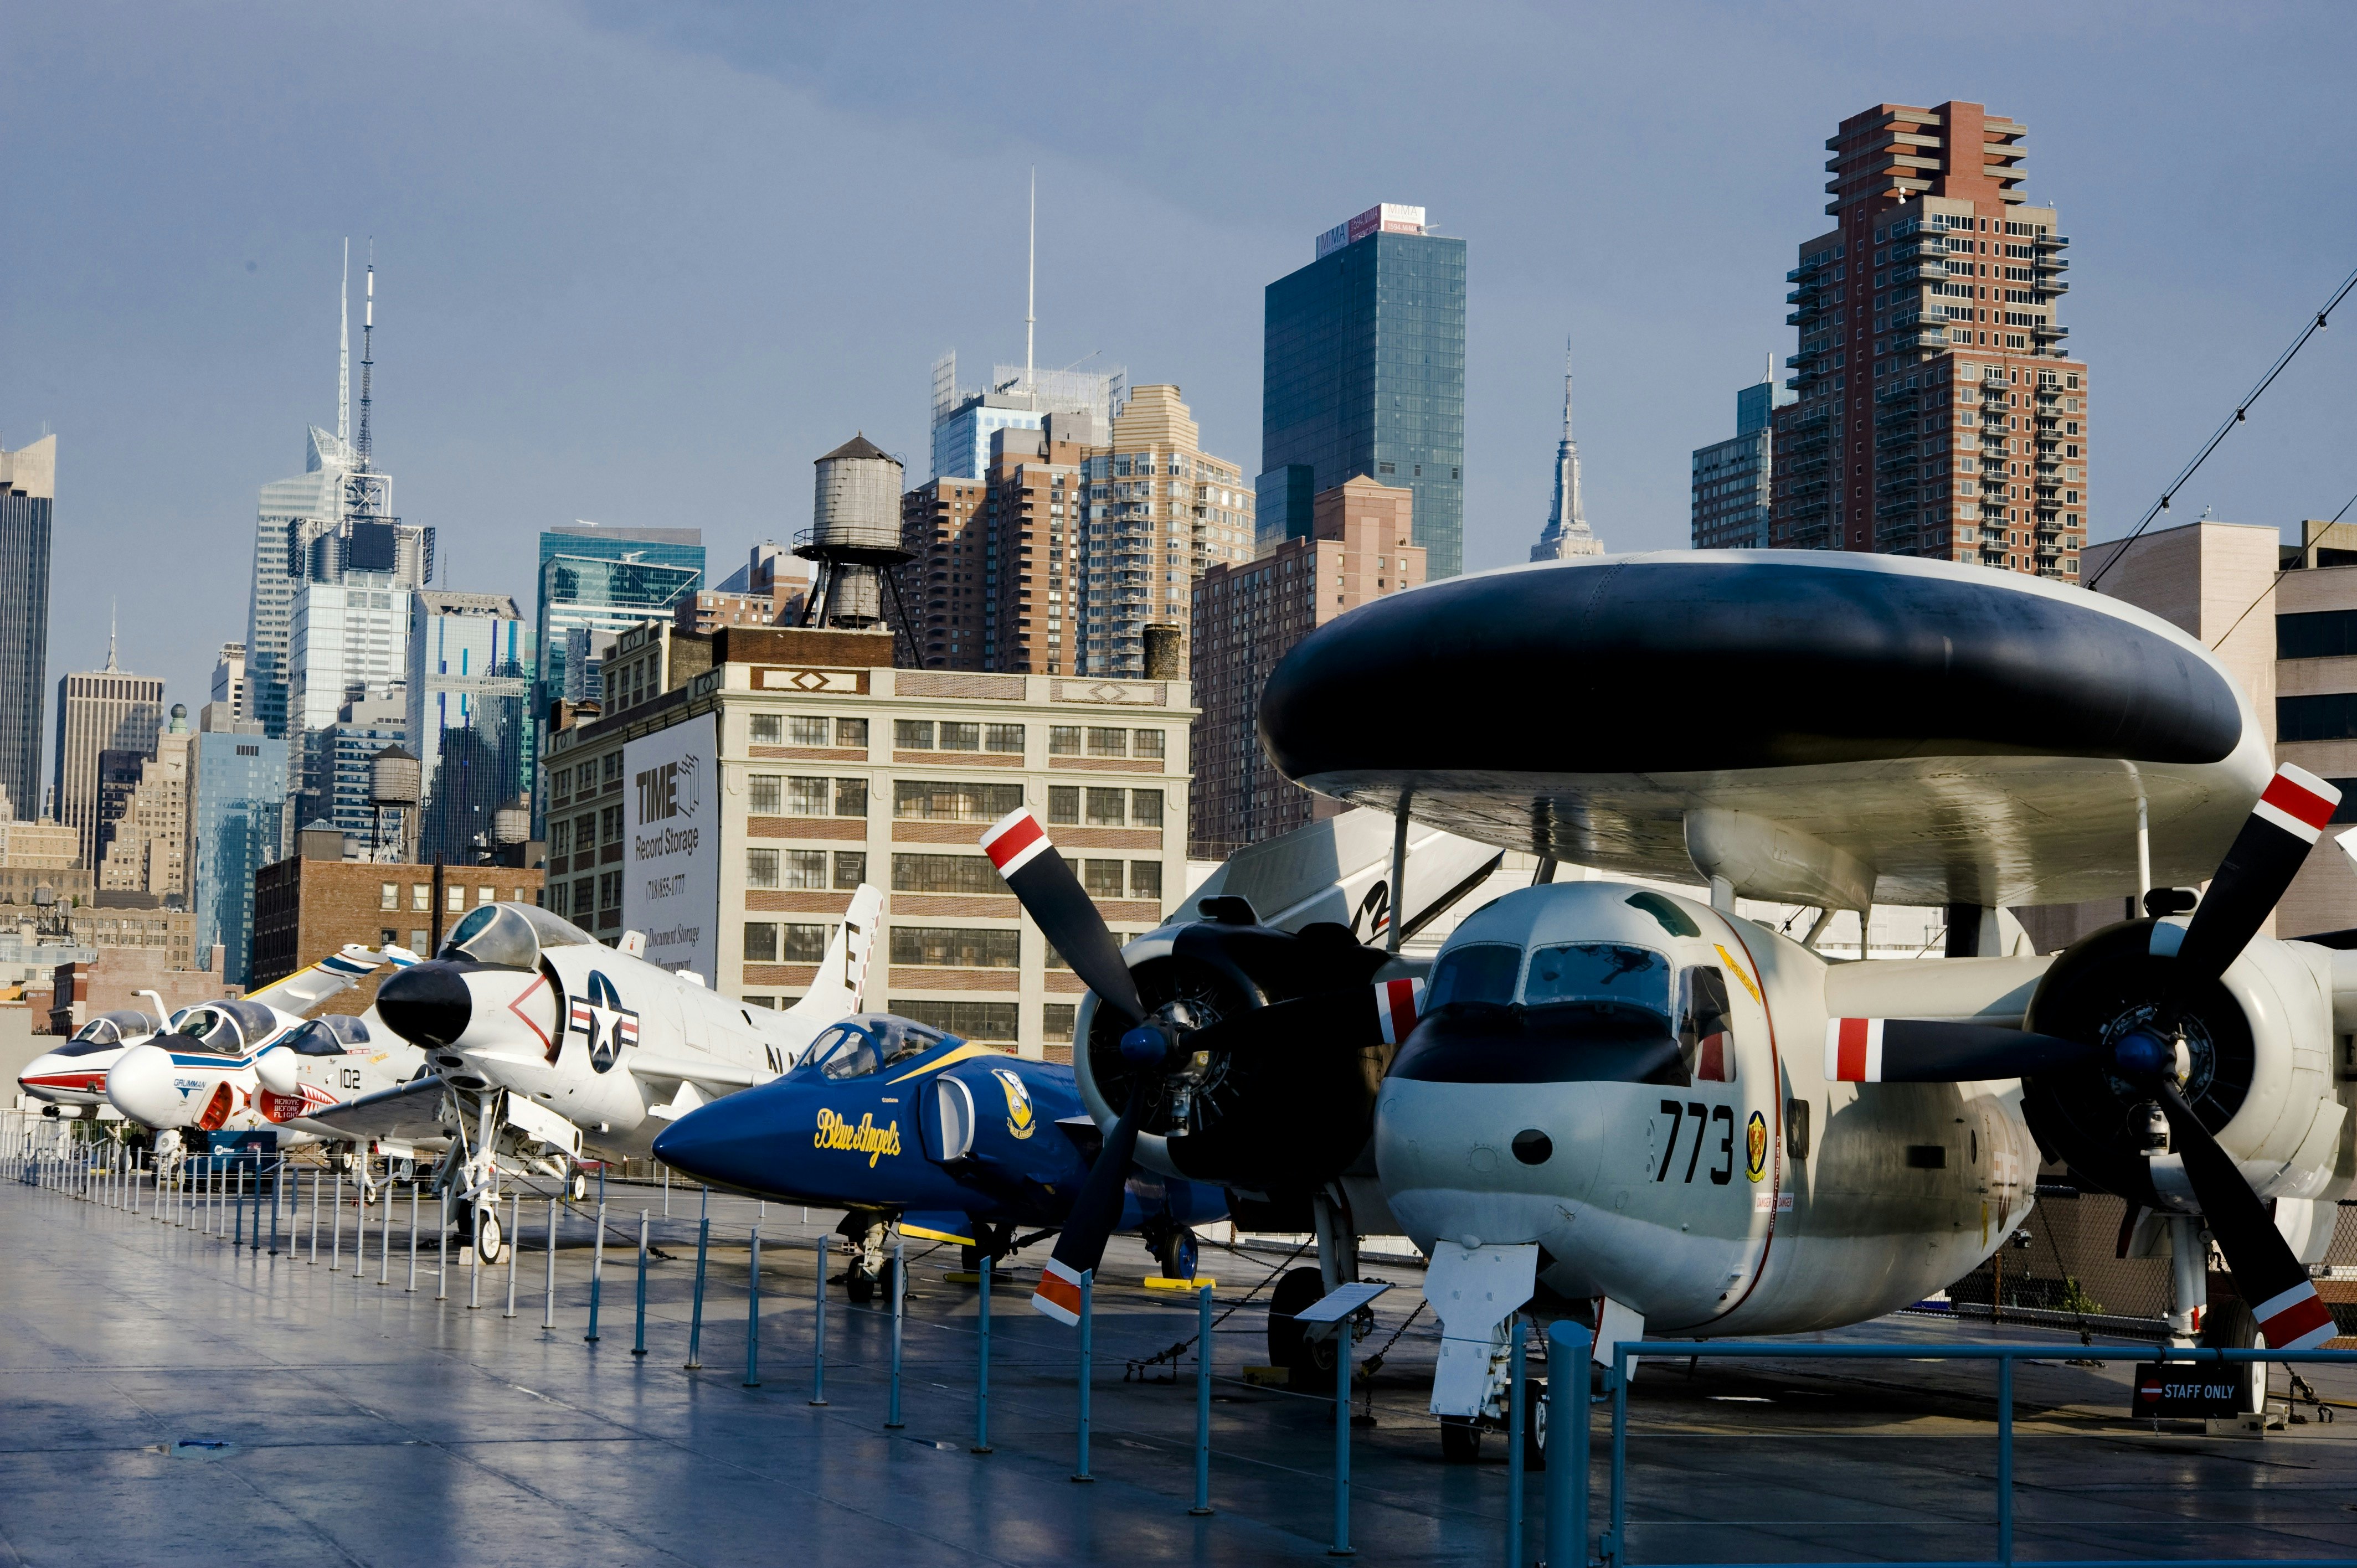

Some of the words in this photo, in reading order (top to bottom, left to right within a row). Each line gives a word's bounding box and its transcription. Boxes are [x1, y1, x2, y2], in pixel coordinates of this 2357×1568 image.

[1321, 224, 1345, 250] MiMA
[636, 761, 677, 825] TIME
[636, 829, 663, 862] Record
[665, 827, 698, 857] Storage
[646, 874, 685, 905] (718)855-1777
[649, 928, 676, 947] Document
[677, 924, 699, 947] Storage
[1730, 959, 1757, 996] RESCUE
[173, 1079, 207, 1088] GRUMMAN
[340, 1068, 360, 1090] 102
[814, 1108, 854, 1151] Blue
[853, 1113, 901, 1168] Angels
[1656, 1099, 1734, 1185] 773
[1769, 1136, 1780, 1232] PROPELLER
[1757, 1197, 1772, 1208] DANGER
[1778, 1197, 1792, 1208] DANGER
[2165, 1384, 2201, 1398] STAFF
[2204, 1385, 2235, 1399] ONLY
